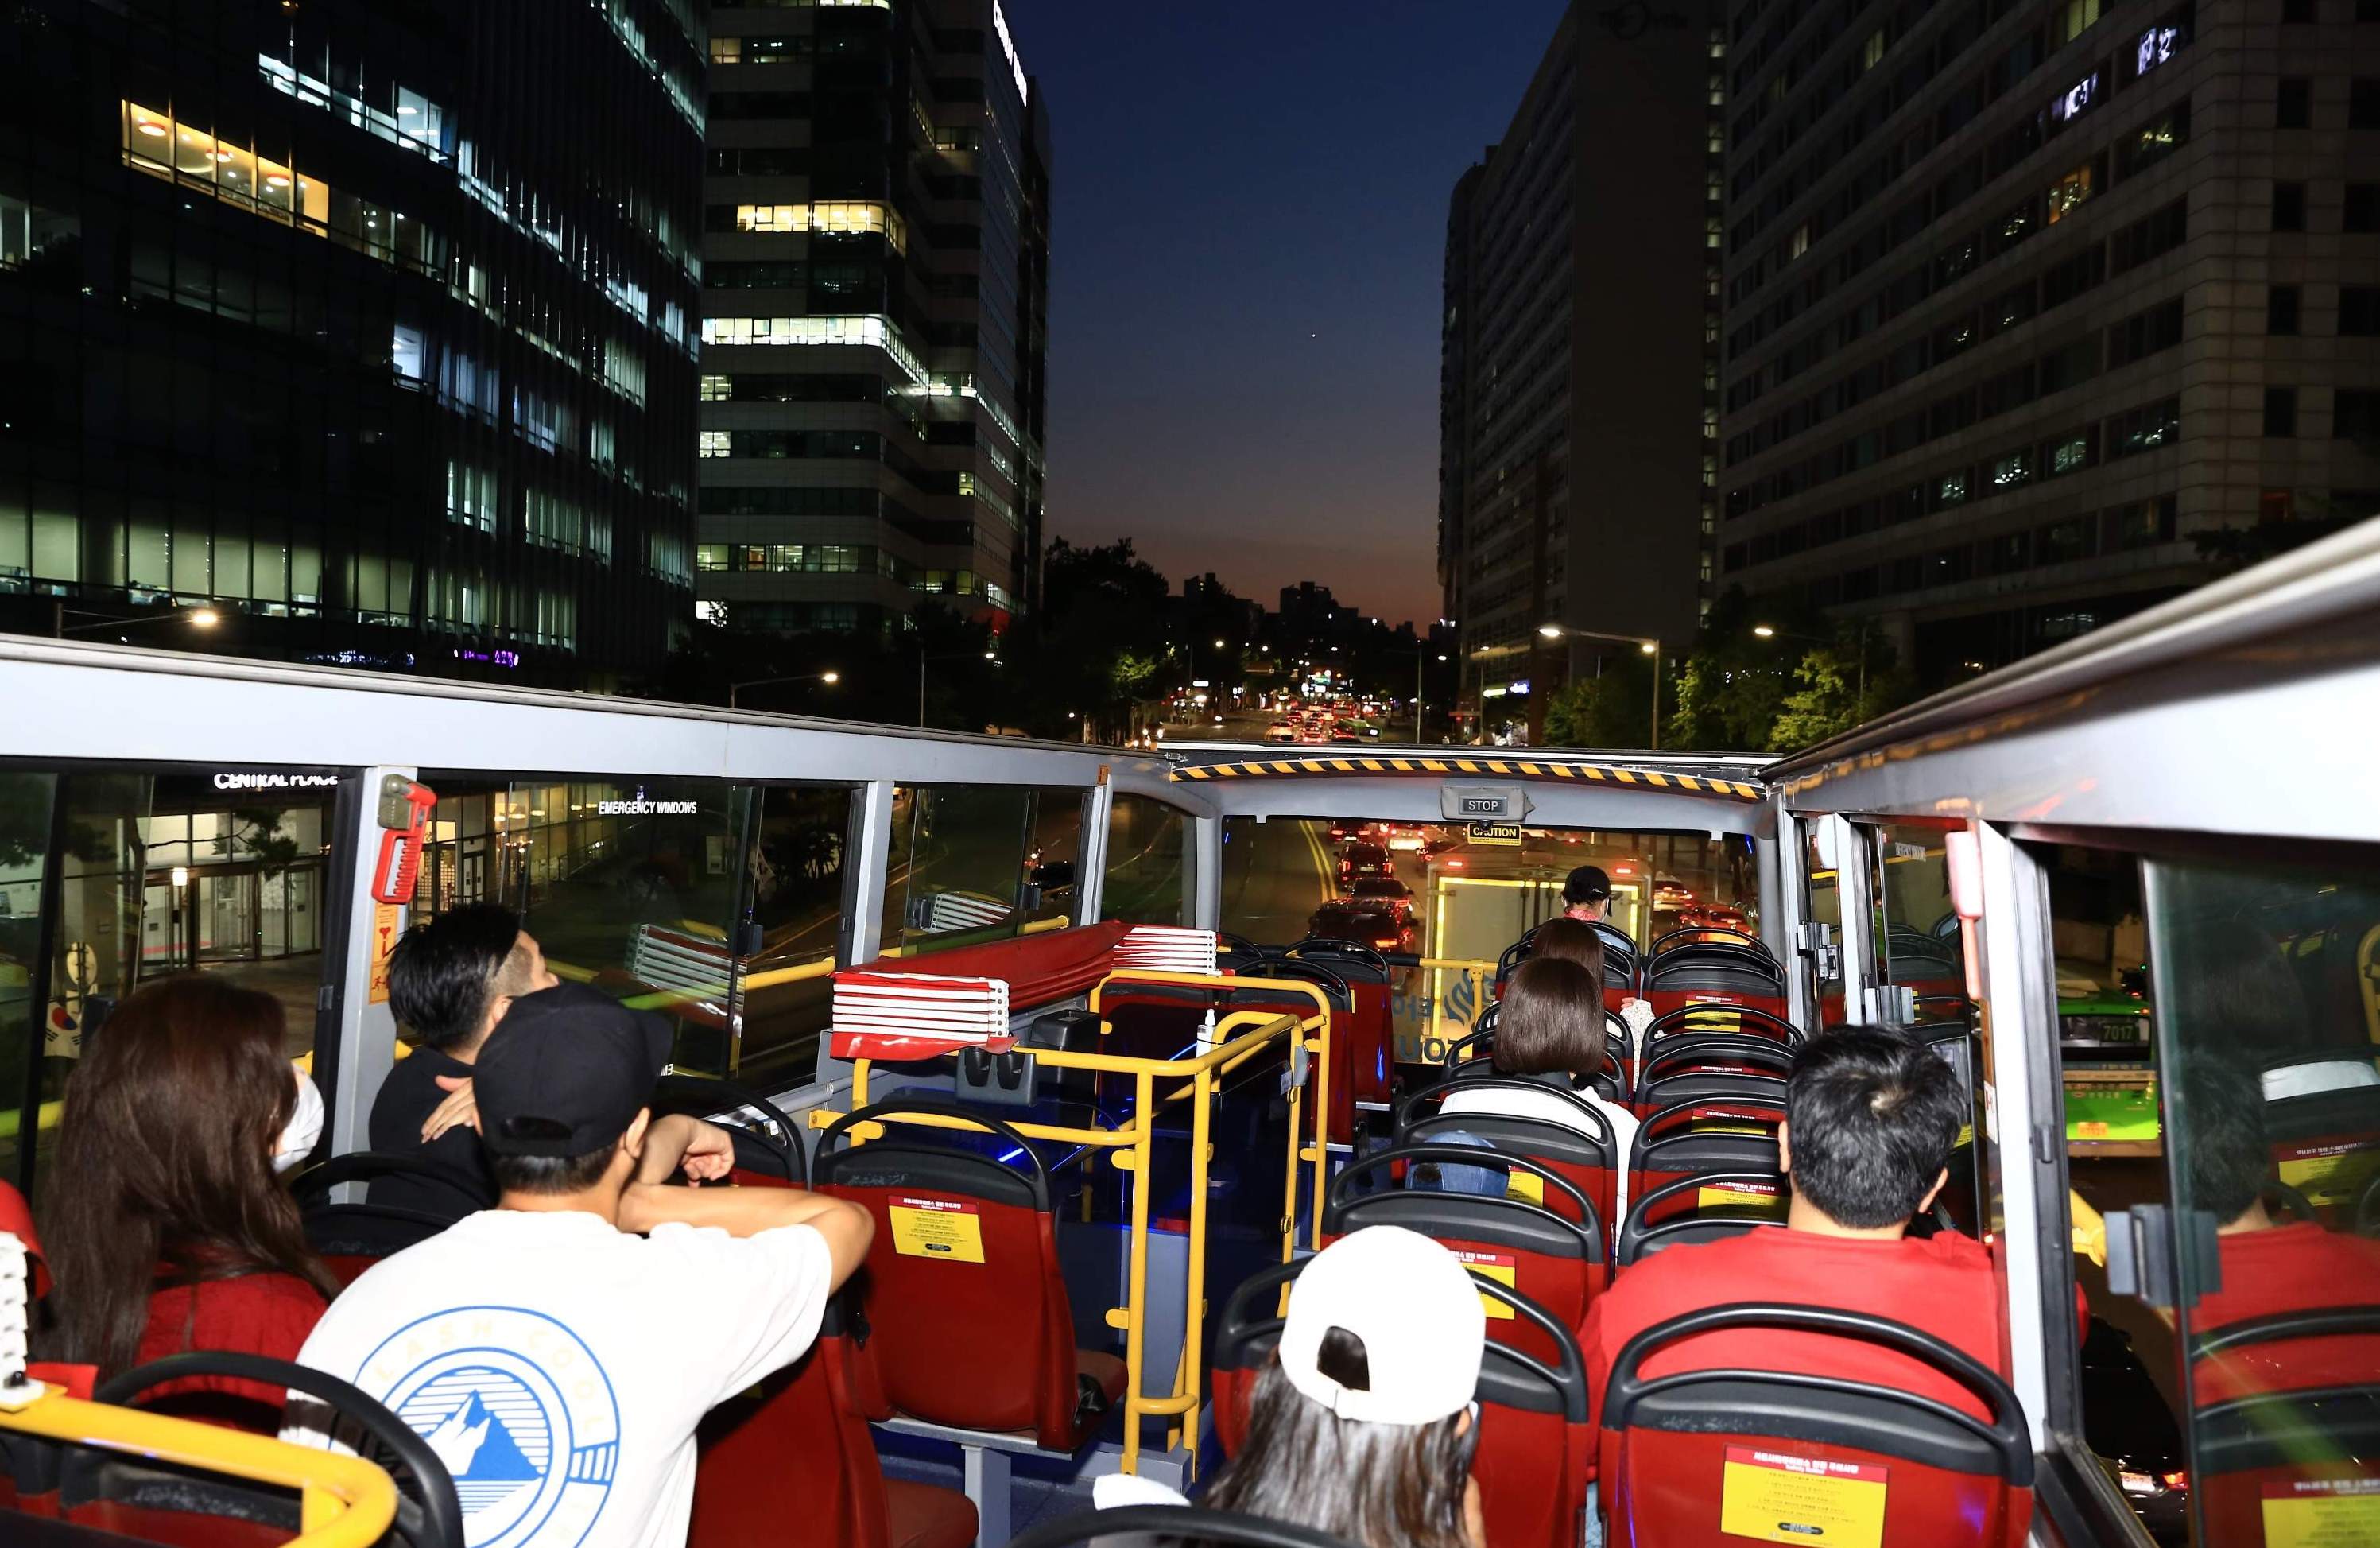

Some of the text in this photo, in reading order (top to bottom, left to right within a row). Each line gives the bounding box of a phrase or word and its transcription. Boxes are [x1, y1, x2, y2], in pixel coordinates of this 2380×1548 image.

[598, 801, 697, 815] EMERGENCY WINDOWS
[1468, 800, 1498, 811] STOP
[2103, 1025, 2134, 1041] 7017
